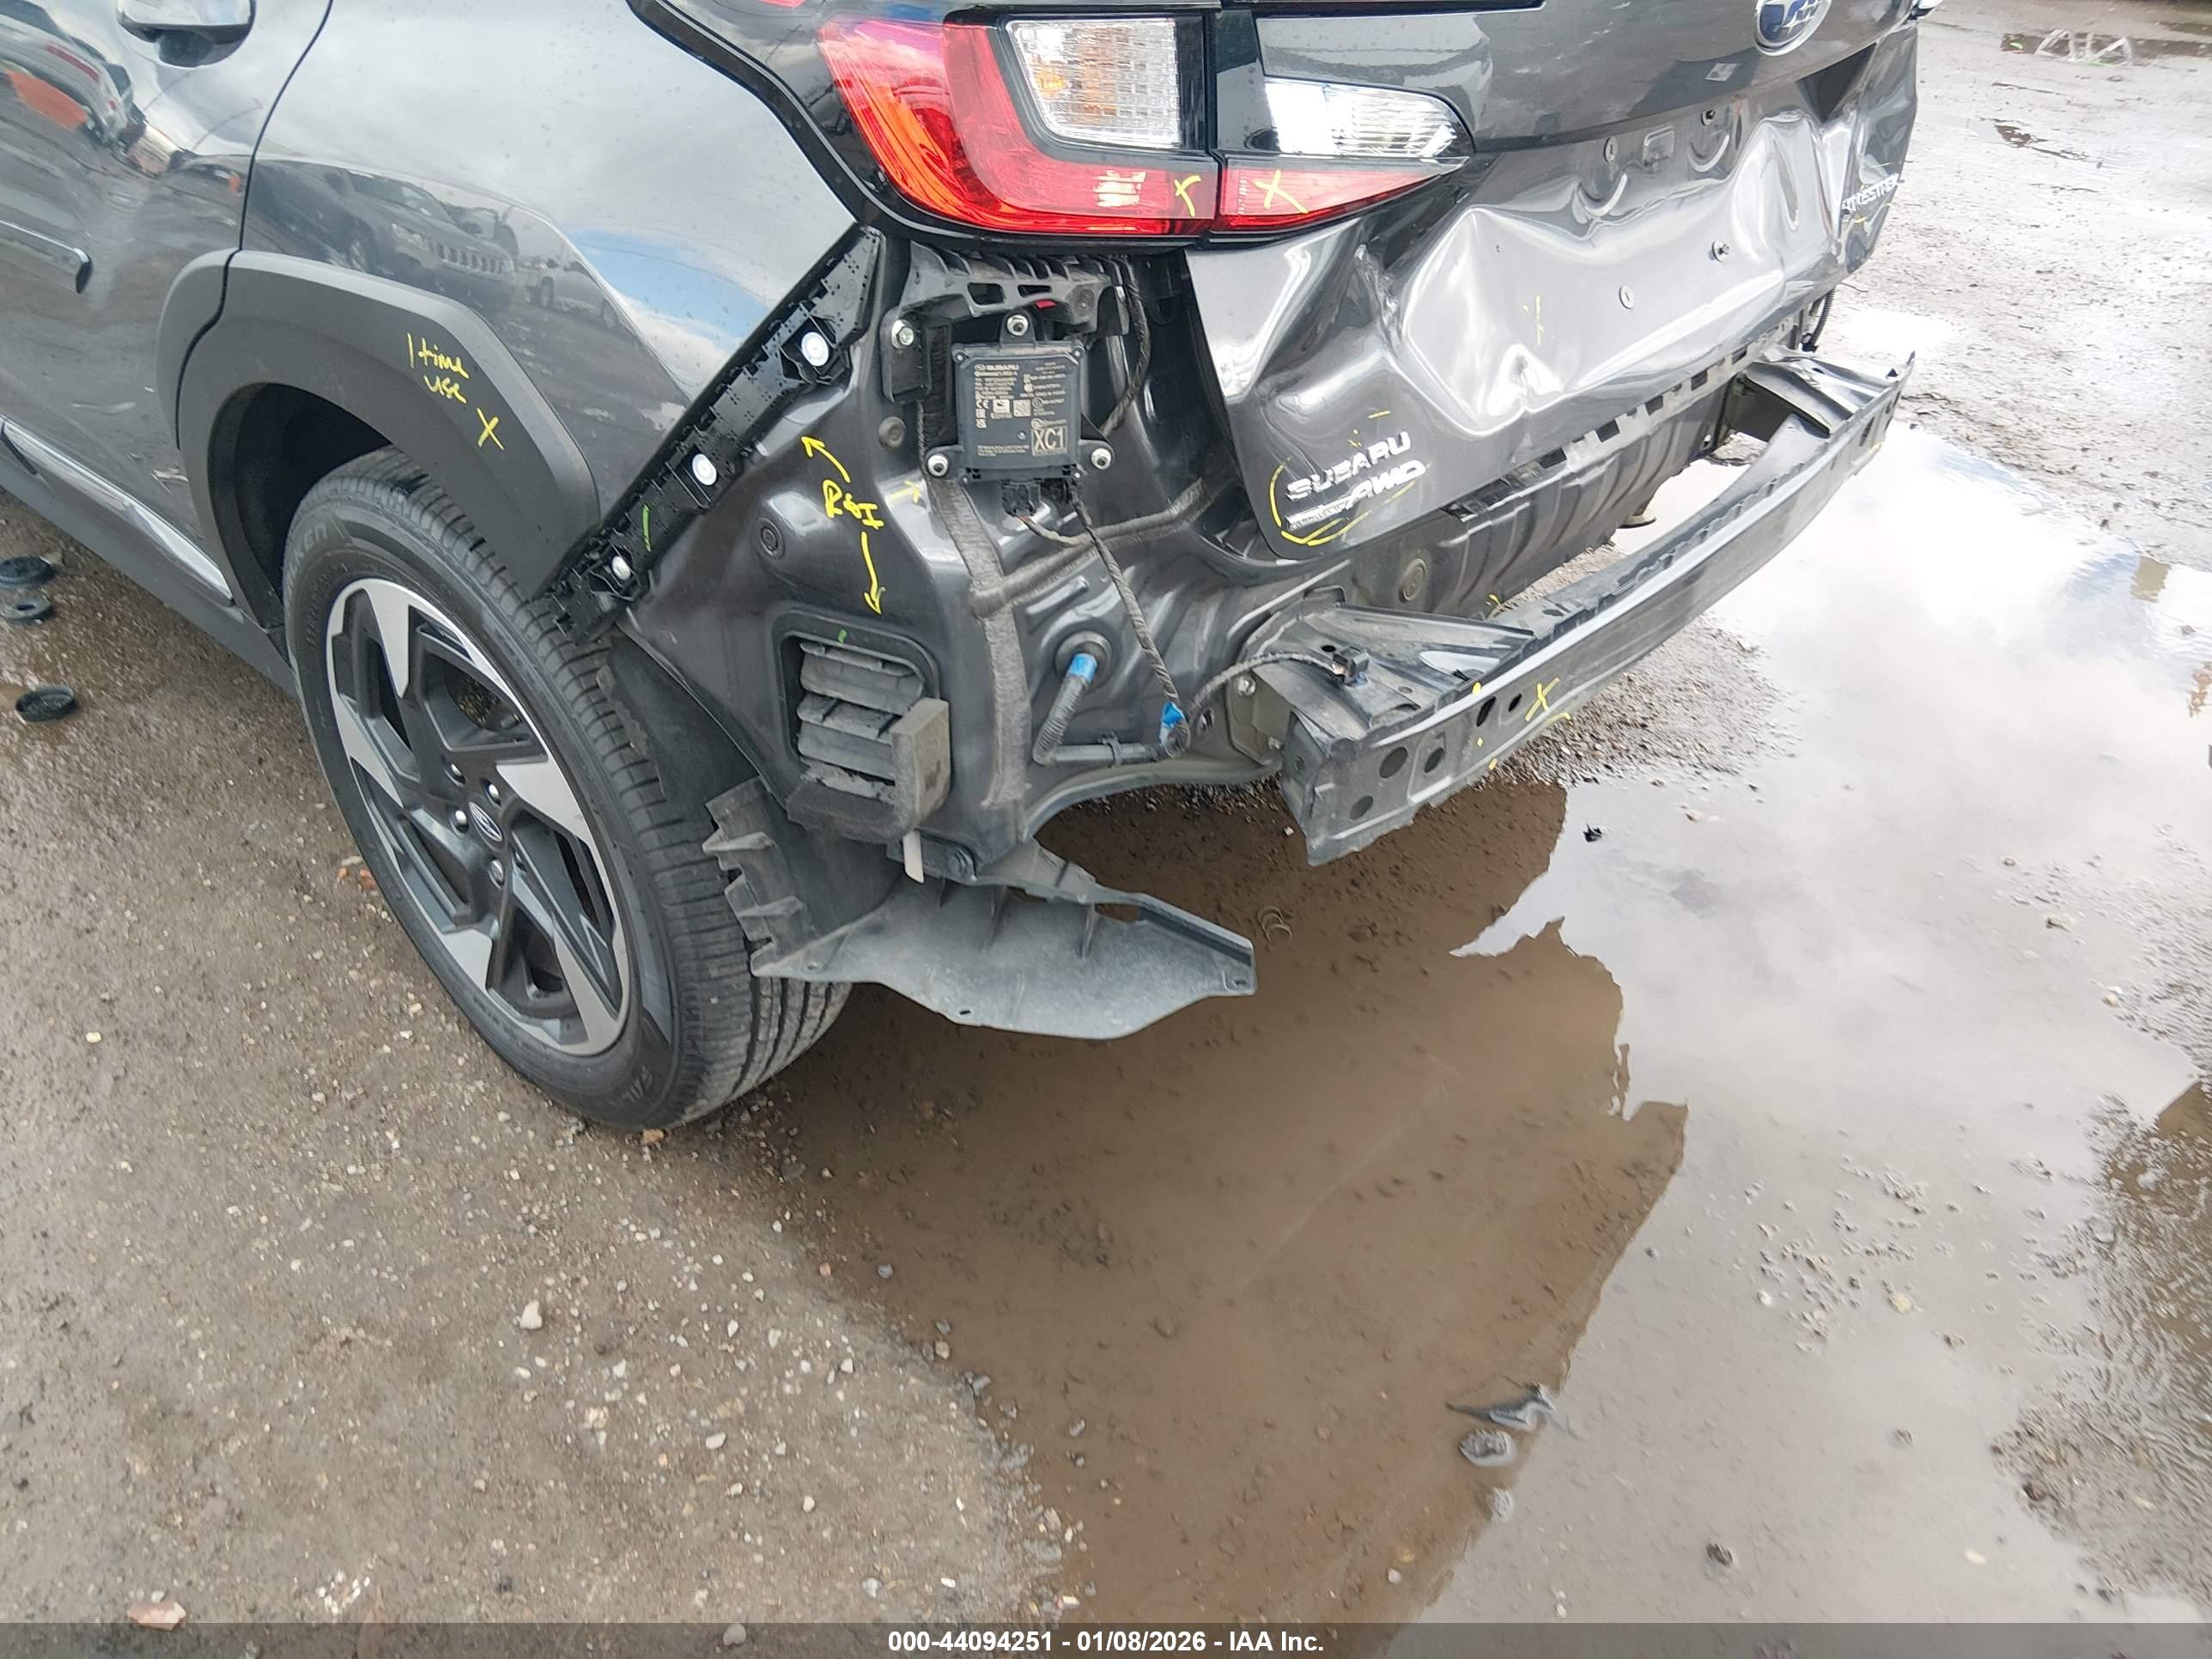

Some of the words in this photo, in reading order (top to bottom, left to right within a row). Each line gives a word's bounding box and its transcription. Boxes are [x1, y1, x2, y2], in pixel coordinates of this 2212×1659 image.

[1035, 427, 1064, 451] XC1
[1285, 431, 1412, 501] SUBARU
[1351, 459, 1426, 510] AWD
